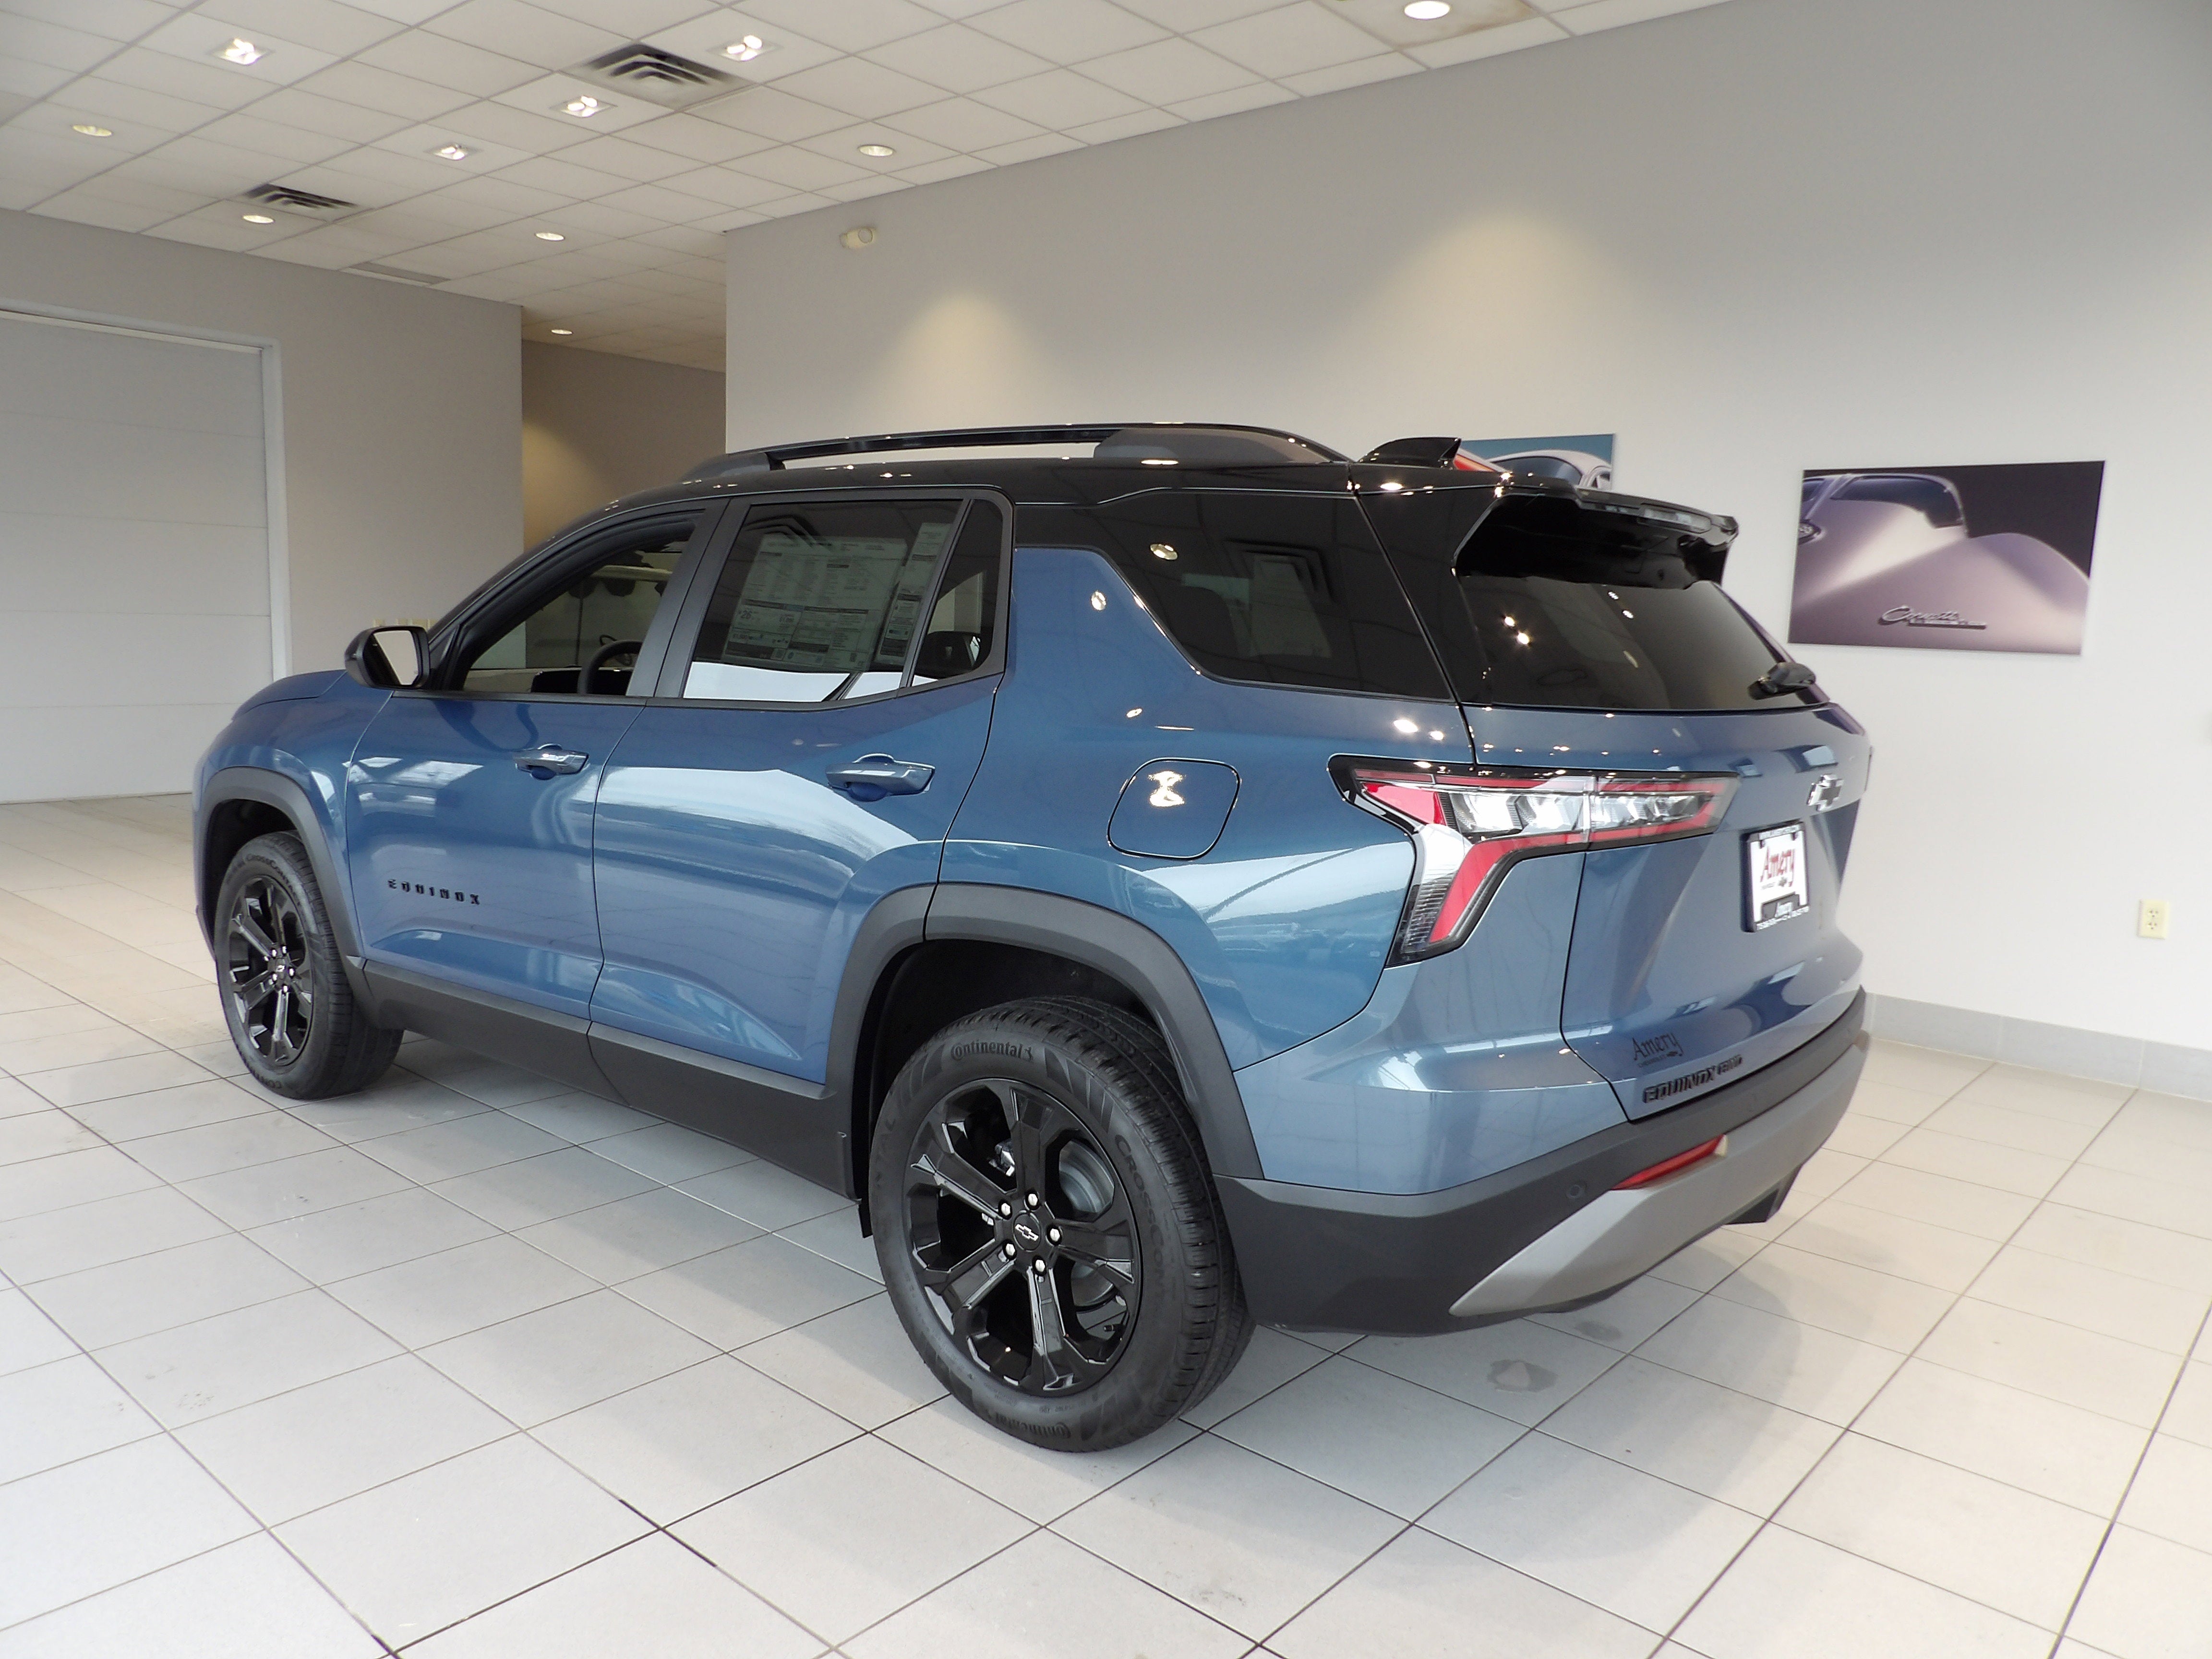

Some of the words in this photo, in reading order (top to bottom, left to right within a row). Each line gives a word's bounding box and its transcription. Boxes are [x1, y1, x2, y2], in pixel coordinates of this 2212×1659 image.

[1760, 846, 1795, 888] Amery
[388, 879, 480, 905] EQUINOX
[951, 1039, 1022, 1061] Continental
[1633, 1032, 1683, 1060] Amery
[1643, 1065, 1716, 1103] EQUINOX
